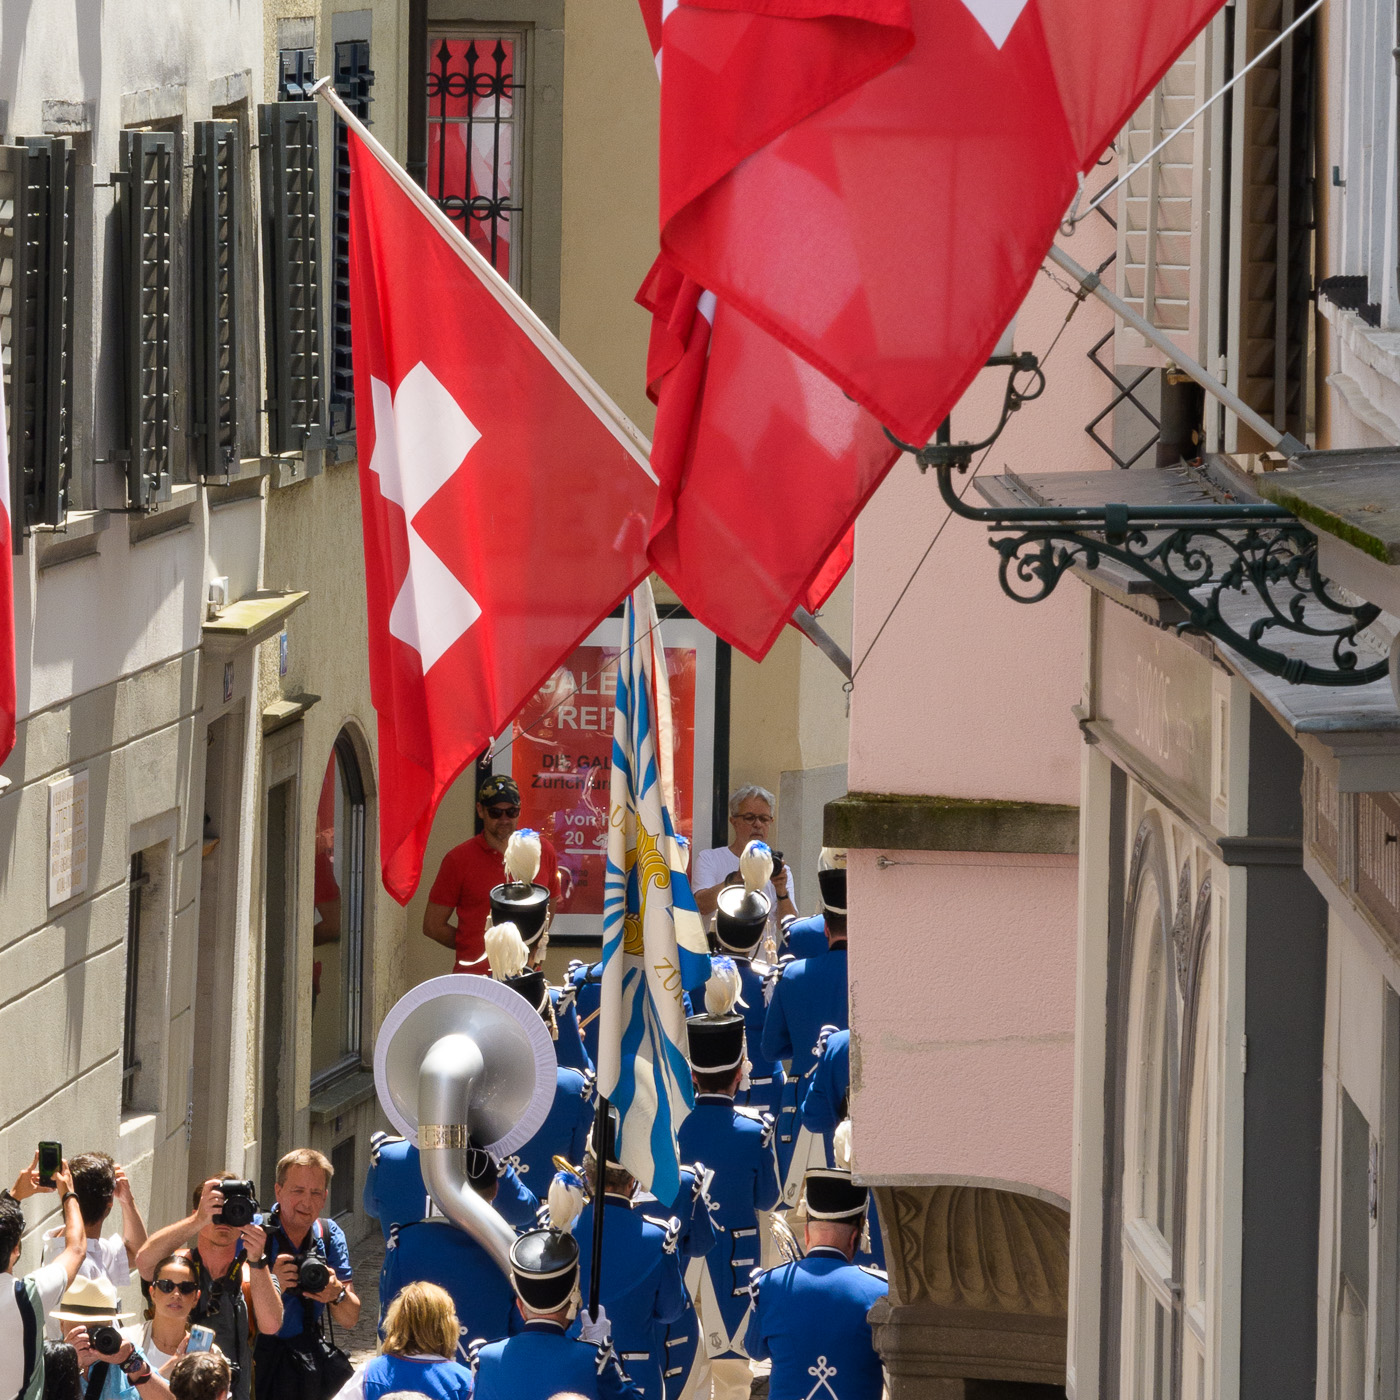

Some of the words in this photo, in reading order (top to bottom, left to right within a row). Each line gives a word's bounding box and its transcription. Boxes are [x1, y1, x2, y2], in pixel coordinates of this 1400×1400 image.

[542, 754, 571, 769] DIE
[577, 754, 611, 770] GAL
[531, 773, 585, 790] Zürich
[564, 814, 596, 826] von
[564, 831, 585, 845] 20
